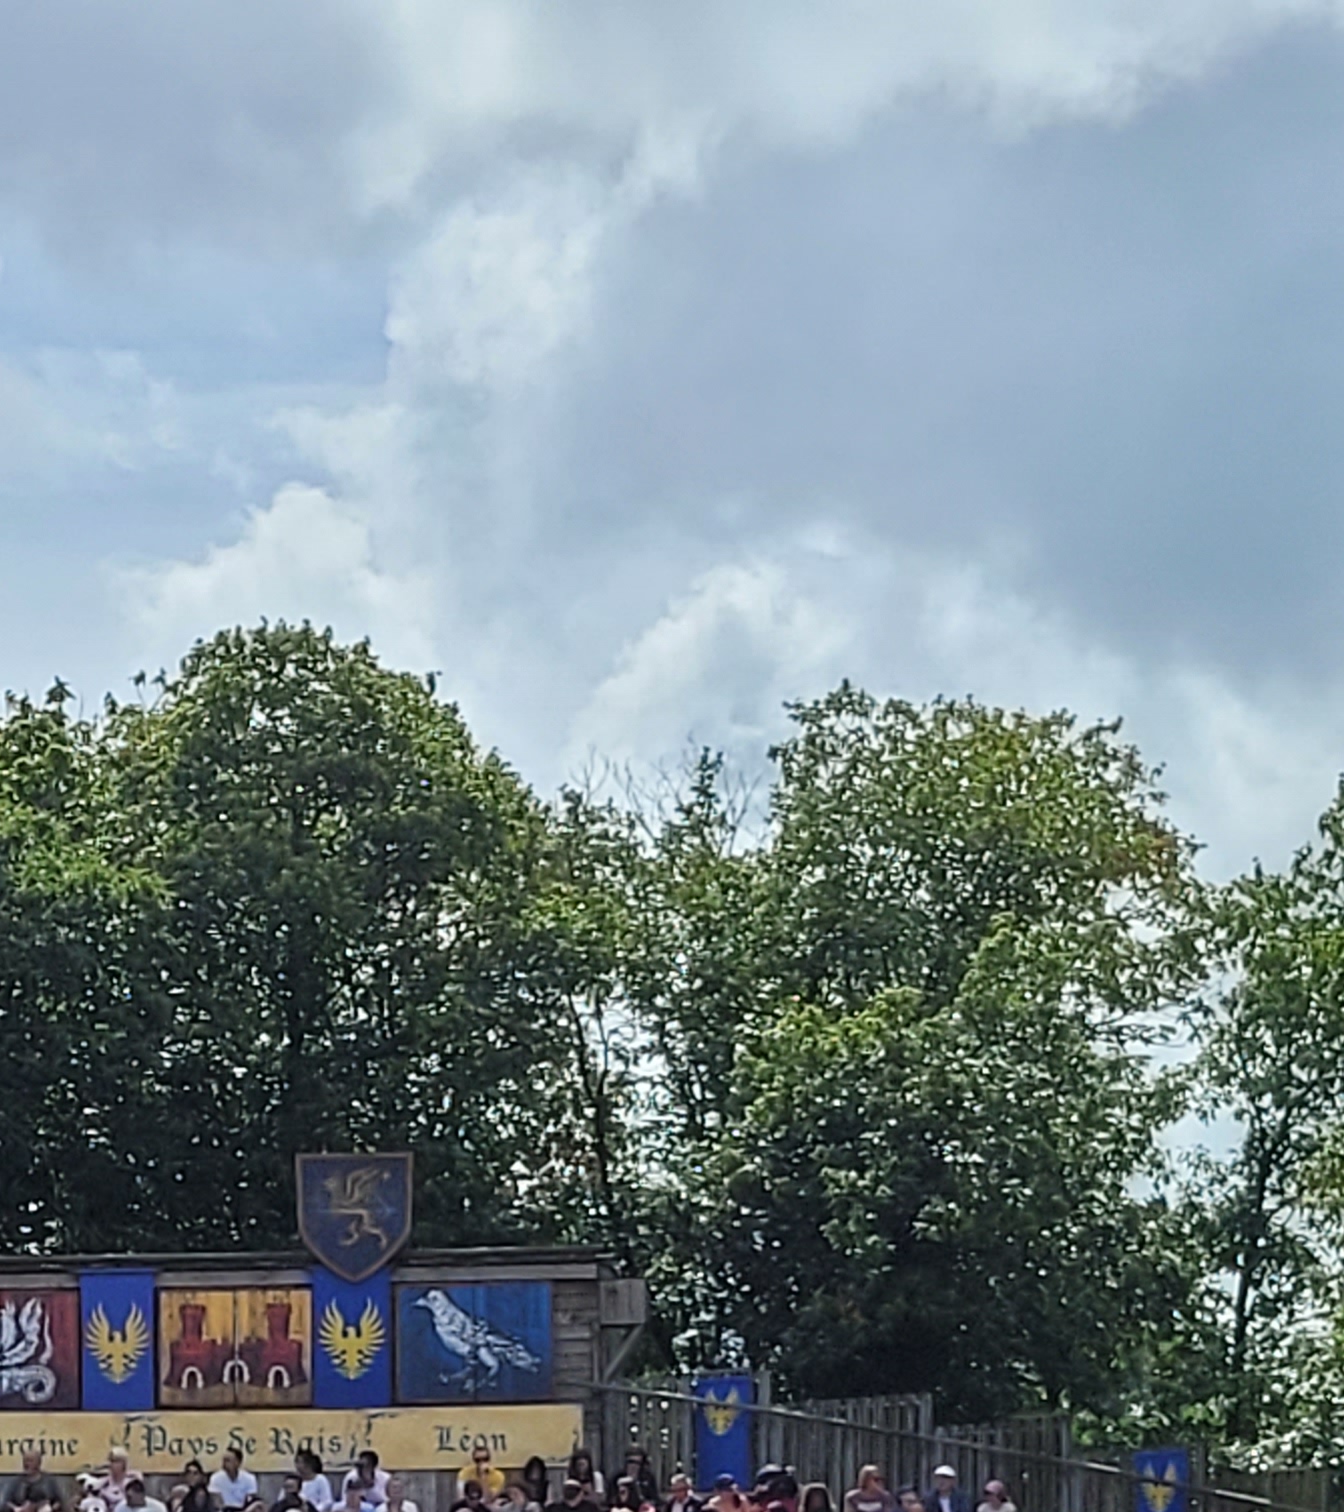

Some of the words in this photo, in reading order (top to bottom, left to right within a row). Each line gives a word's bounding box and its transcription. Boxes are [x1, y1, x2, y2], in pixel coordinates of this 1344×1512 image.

[141, 1423, 218, 1458] Pays
[228, 1425, 257, 1455] de
[269, 1425, 343, 1455] Rais
[434, 1424, 508, 1452] Léon
